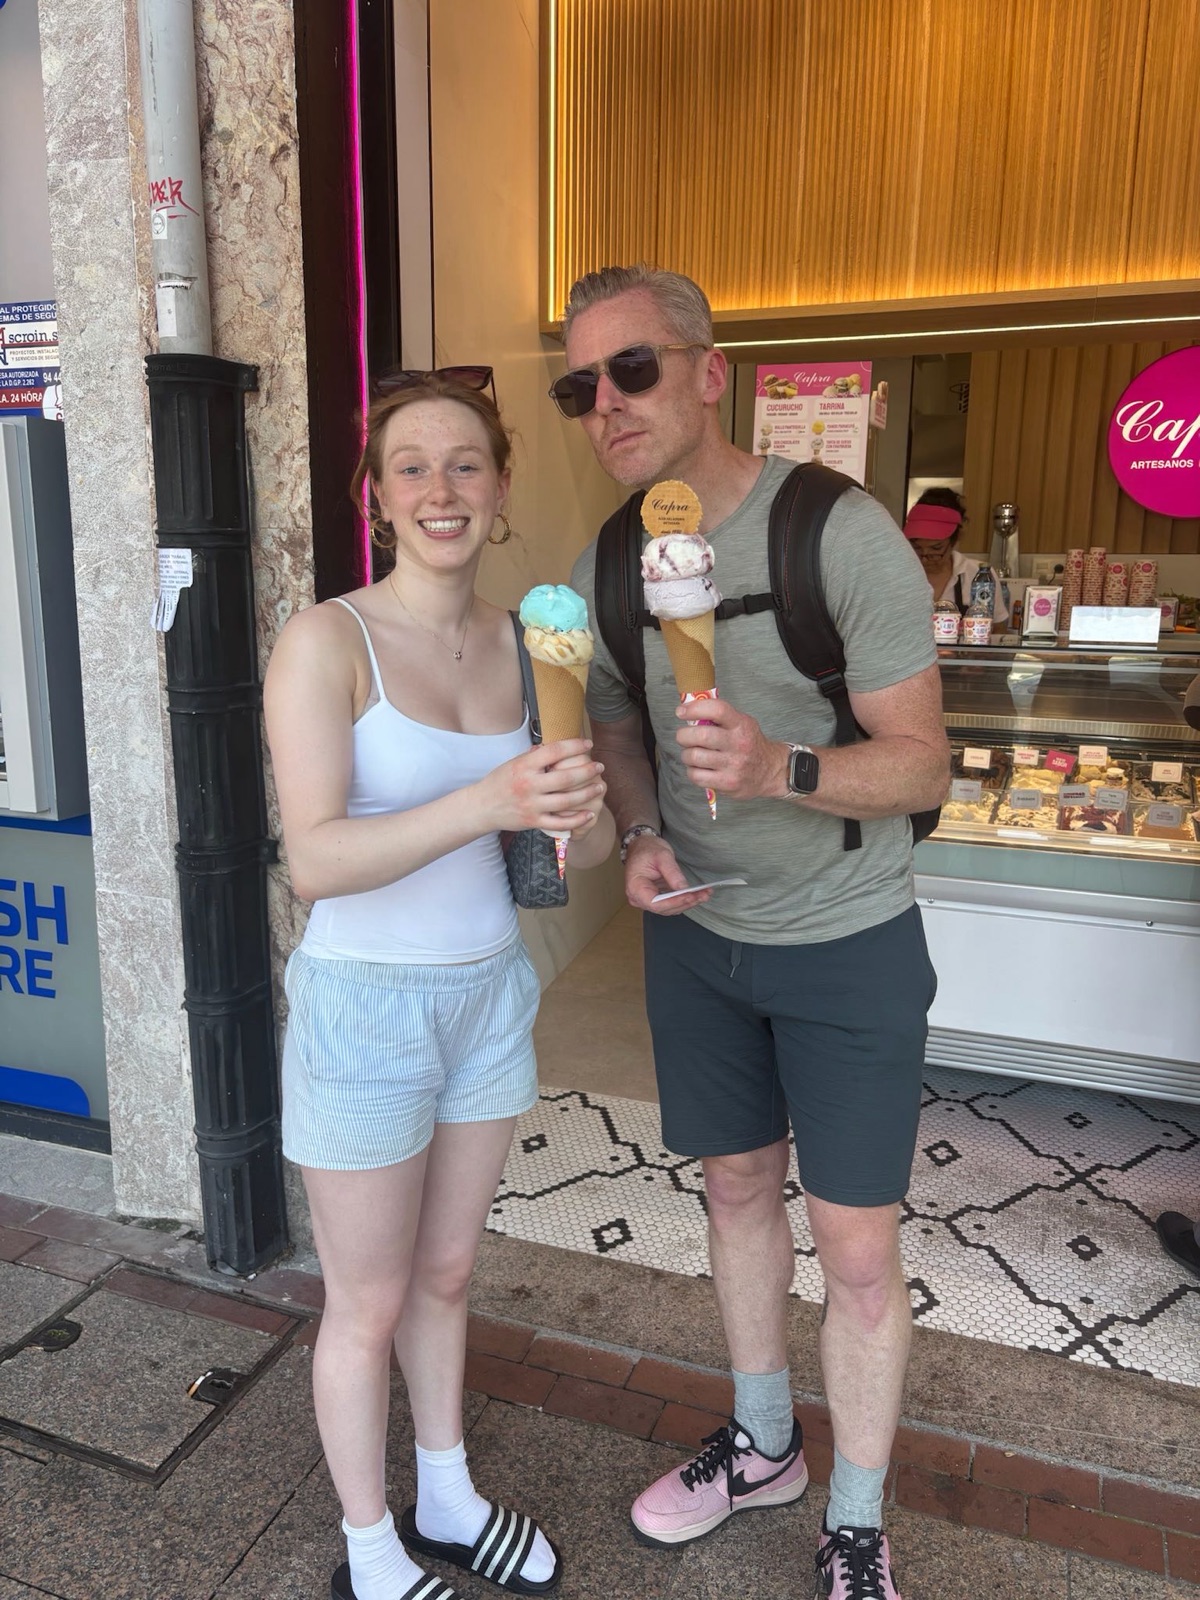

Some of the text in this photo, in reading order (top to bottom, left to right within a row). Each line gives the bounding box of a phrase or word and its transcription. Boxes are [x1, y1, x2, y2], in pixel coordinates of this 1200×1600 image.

[22, 313, 33, 321] DE
[34, 311, 57, 320] SEGU
[9, 370, 40, 379] AUTORIZADA
[42, 372, 53, 383] 94
[793, 371, 831, 388] Capra
[10, 393, 20, 403] 24
[766, 403, 803, 411] CUCURUCHO
[819, 402, 845, 410] TARRINA
[1130, 459, 1194, 470] ARTESANOS
[651, 499, 689, 515] Capra
